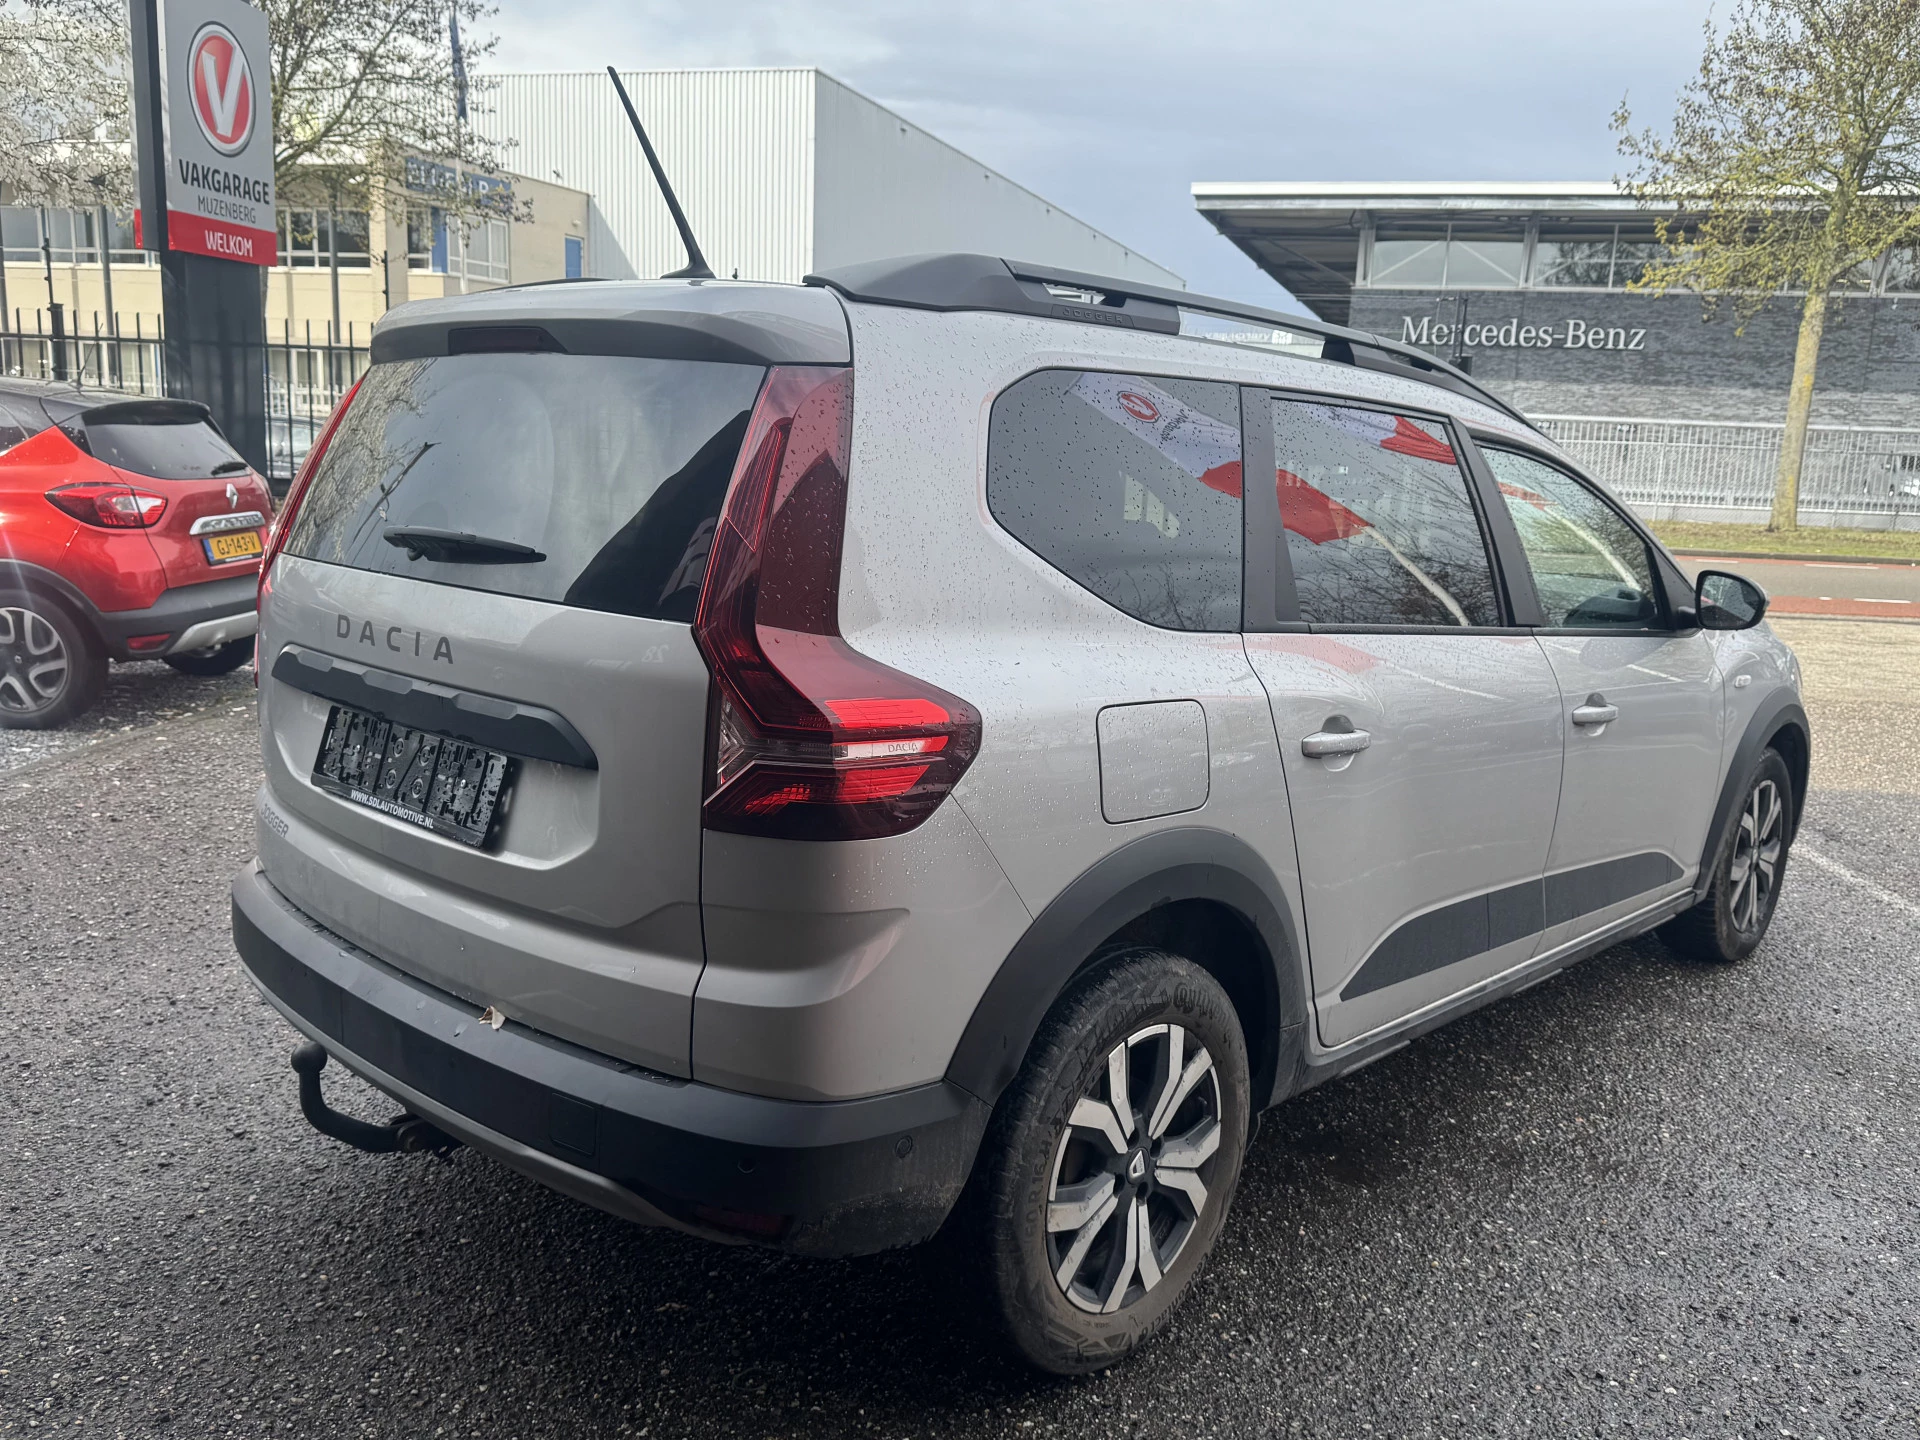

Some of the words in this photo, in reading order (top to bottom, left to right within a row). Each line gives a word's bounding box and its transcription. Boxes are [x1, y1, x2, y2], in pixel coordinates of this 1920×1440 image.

[178, 159, 271, 205] VAKGARAGE
[197, 195, 257, 224] MUZENBERG
[204, 229, 254, 258] WELKOM
[1061, 307, 1124, 324] JOGGER
[1400, 315, 1648, 351] Mercedes-Benz
[216, 534, 257, 556] GJ-143-V
[336, 613, 455, 665] DACIA
[887, 741, 919, 754] DACIA
[350, 789, 435, 830] WWW.SDLAUTOMOTIVE.NL
